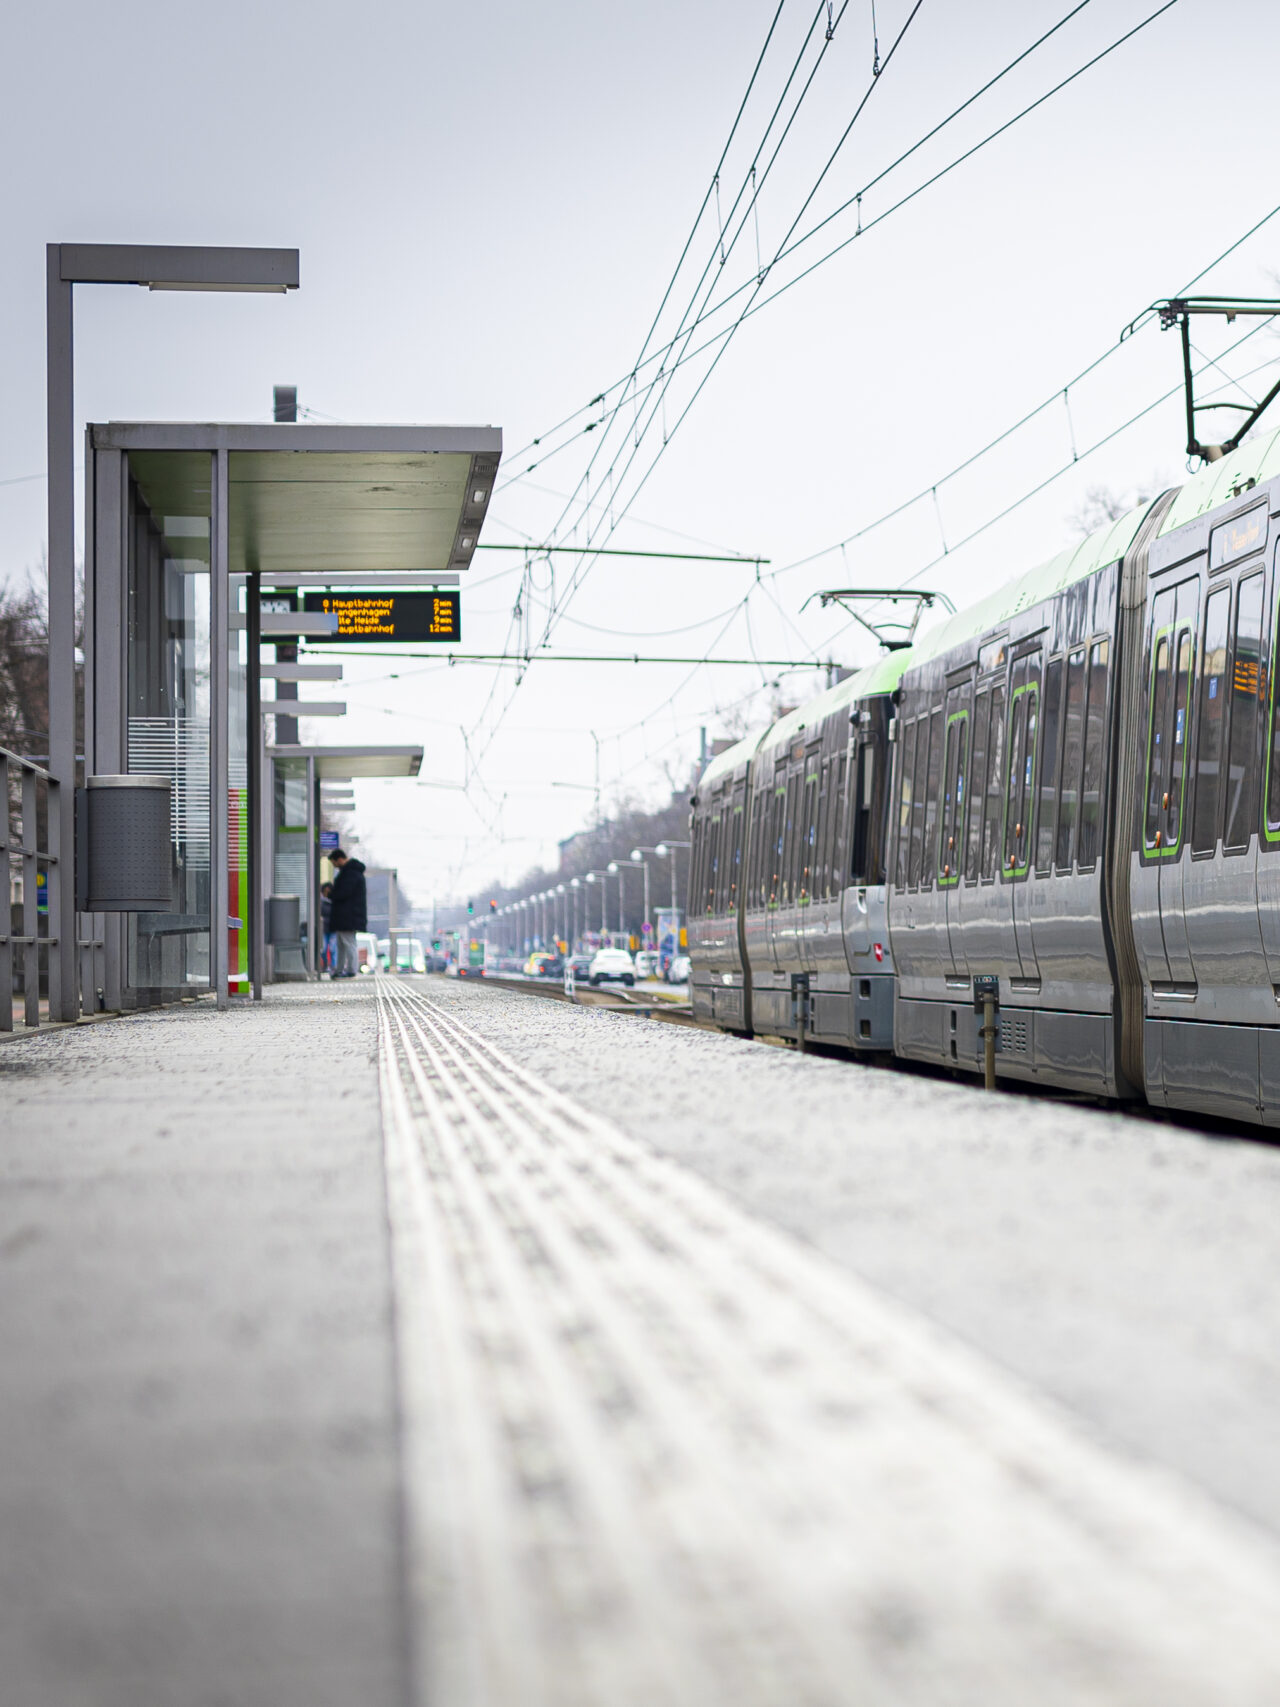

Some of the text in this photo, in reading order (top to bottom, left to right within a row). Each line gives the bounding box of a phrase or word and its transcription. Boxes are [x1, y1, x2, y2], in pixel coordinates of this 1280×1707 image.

[332, 598, 395, 610] Hauptbahnhof
[338, 616, 351, 625] lte
[354, 616, 380, 625] Heide
[338, 624, 395, 635] auptbahnhof
